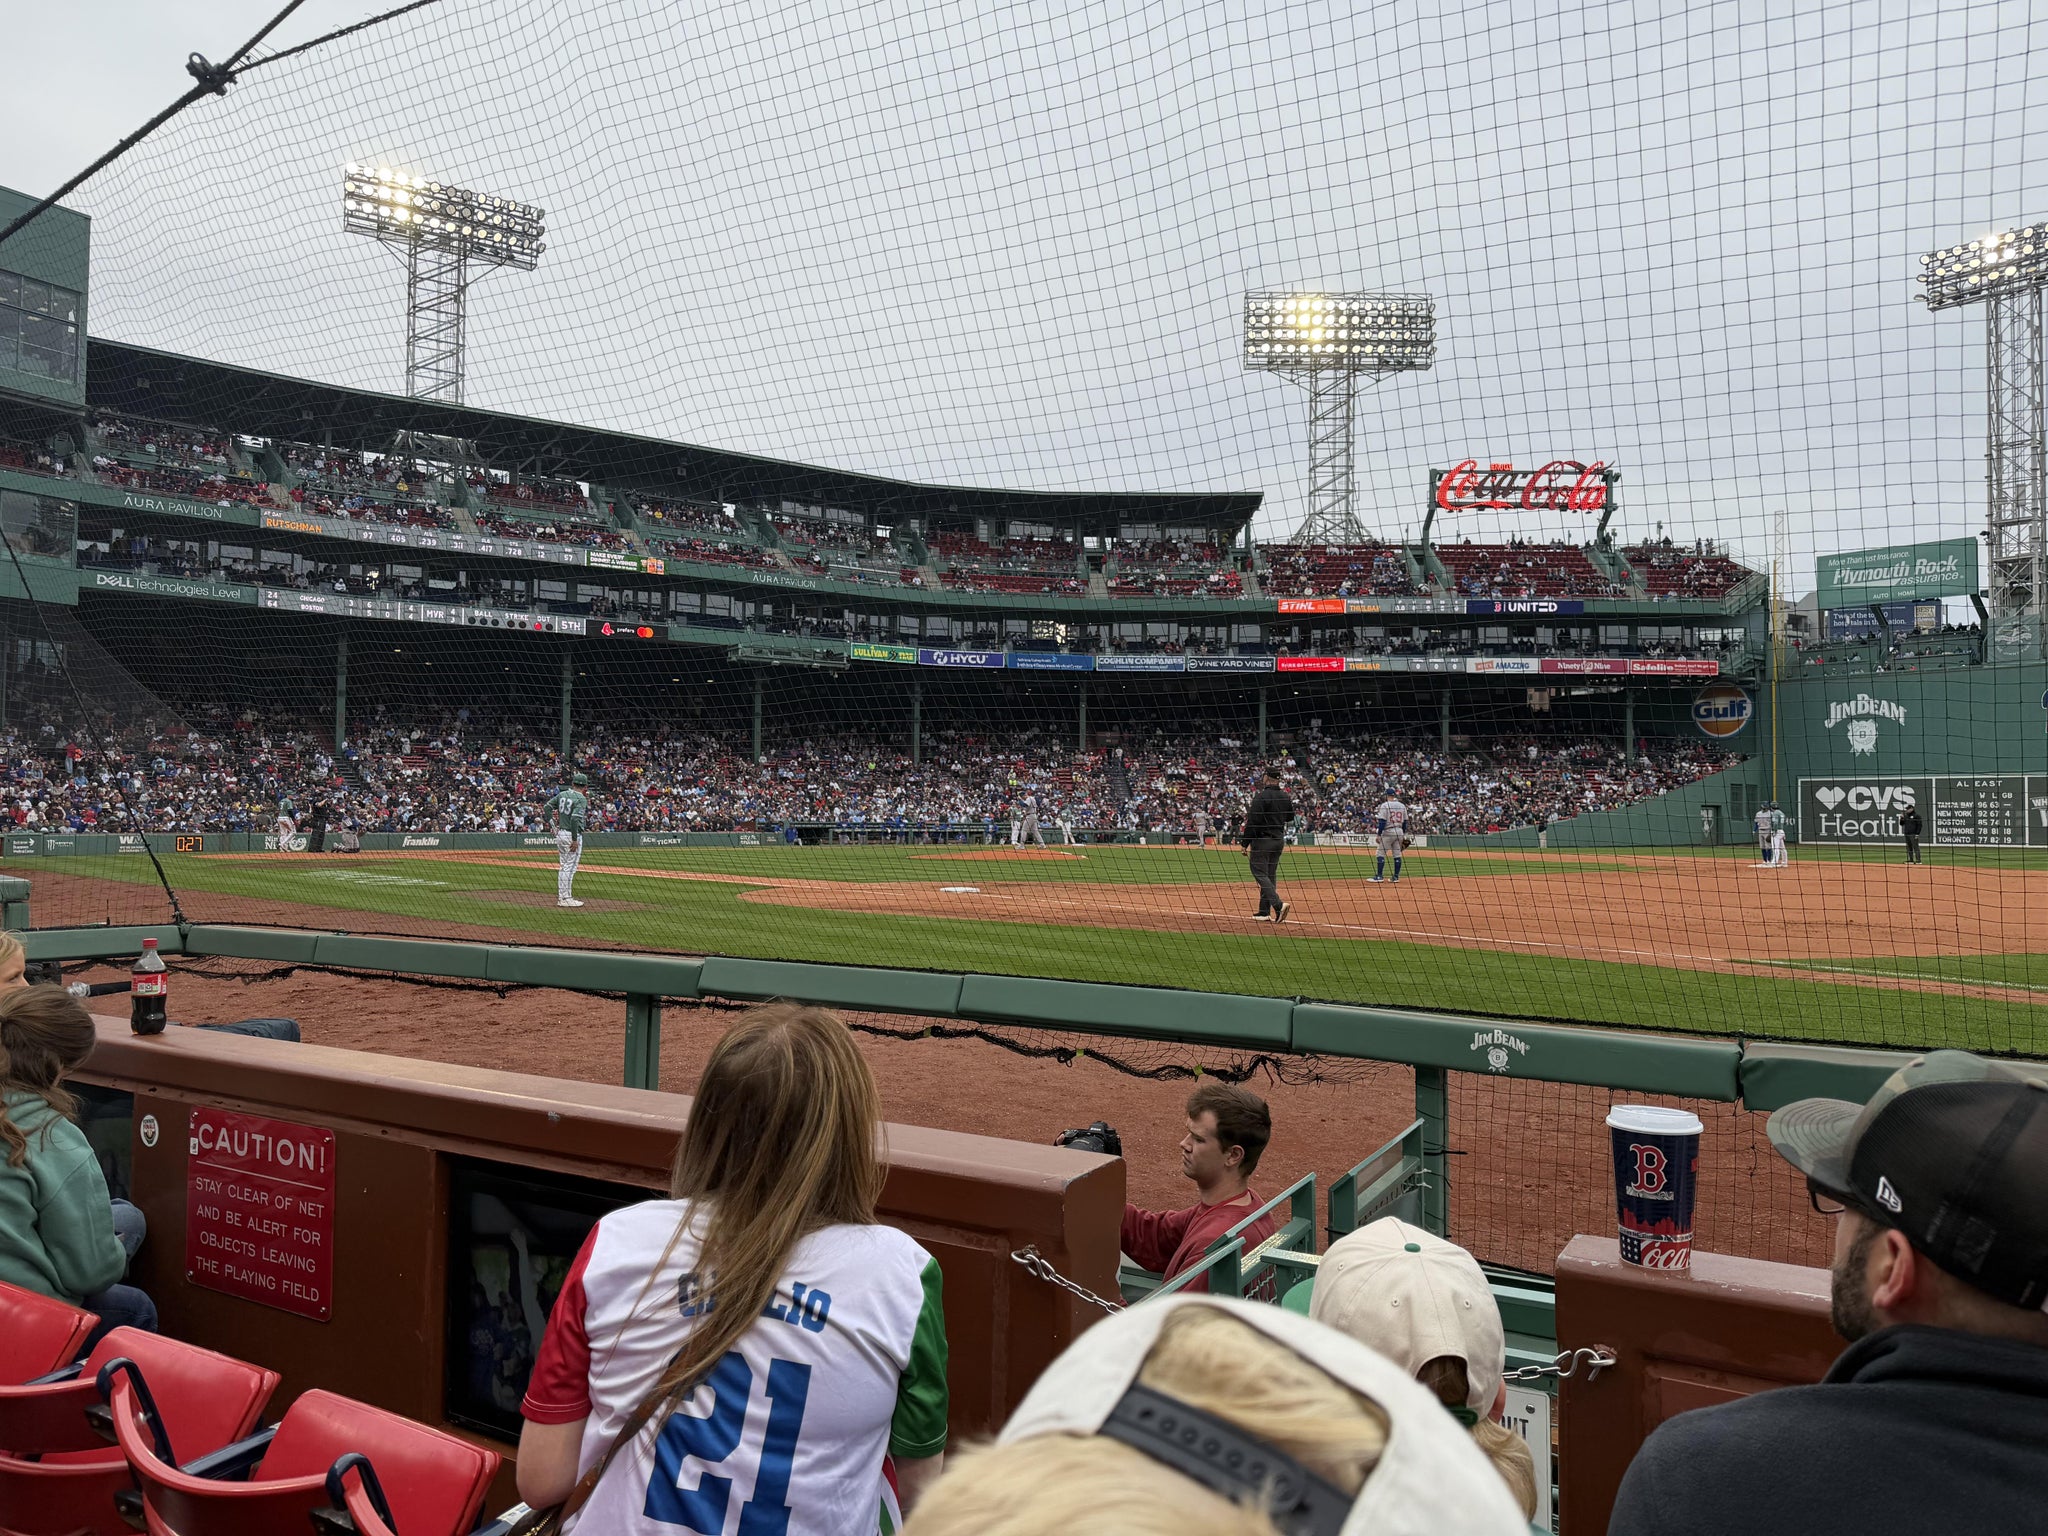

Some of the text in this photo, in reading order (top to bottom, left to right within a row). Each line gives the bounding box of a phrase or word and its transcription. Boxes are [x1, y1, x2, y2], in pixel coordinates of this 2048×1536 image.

[168, 502, 222, 518] PAVILION
[266, 518, 322, 533] RUTSCHMAN
[362, 531, 373, 539] 97
[419, 537, 437, 546] .239
[505, 547, 522, 556] .728
[1828, 558, 1845, 567] More
[1847, 557, 1862, 565] Than
[1877, 551, 1910, 561] Insurance.
[1833, 555, 1959, 585] Plymouth Rock
[96, 573, 241, 599] DELL Technologies Level
[780, 577, 816, 588] PAVILION
[1900, 571, 1959, 586] assurance
[300, 595, 325, 603] CHICAGO
[1281, 602, 1315, 610] STIHL
[426, 610, 444, 618] MVR
[1508, 602, 1558, 612] UNITED
[474, 610, 493, 618] BALL
[505, 613, 529, 621] STRIKE
[561, 621, 581, 631] 5TH
[853, 648, 888, 658] SULLIVAN
[950, 654, 986, 664] HYCU
[1099, 657, 1184, 665] COGHLIN COMPANIES
[1197, 660, 1272, 668] VINEYARD VINES
[1495, 662, 1529, 670] AMAZING
[1633, 664, 1674, 672] Safelite
[1694, 699, 1747, 719] Gulf
[1824, 693, 1907, 728] JIM BEAM
[1848, 785, 1916, 811] CVS
[558, 797, 573, 815] 83
[1390, 811, 1403, 823] 29
[657, 838, 681, 846] TICKET
[1470, 1029, 1526, 1056] JIM BEAM
[199, 1123, 325, 1174] CAUTION!
[1630, 1144, 1668, 1194] B
[195, 1177, 325, 1219] STAY CLEAR OF NET
[196, 1204, 321, 1247] AND BE ALERT FOR
[200, 1231, 316, 1273] OBJECTS LEAVING
[196, 1256, 319, 1302] THE PLAYING FIELD
[643, 1348, 812, 1536] 21
